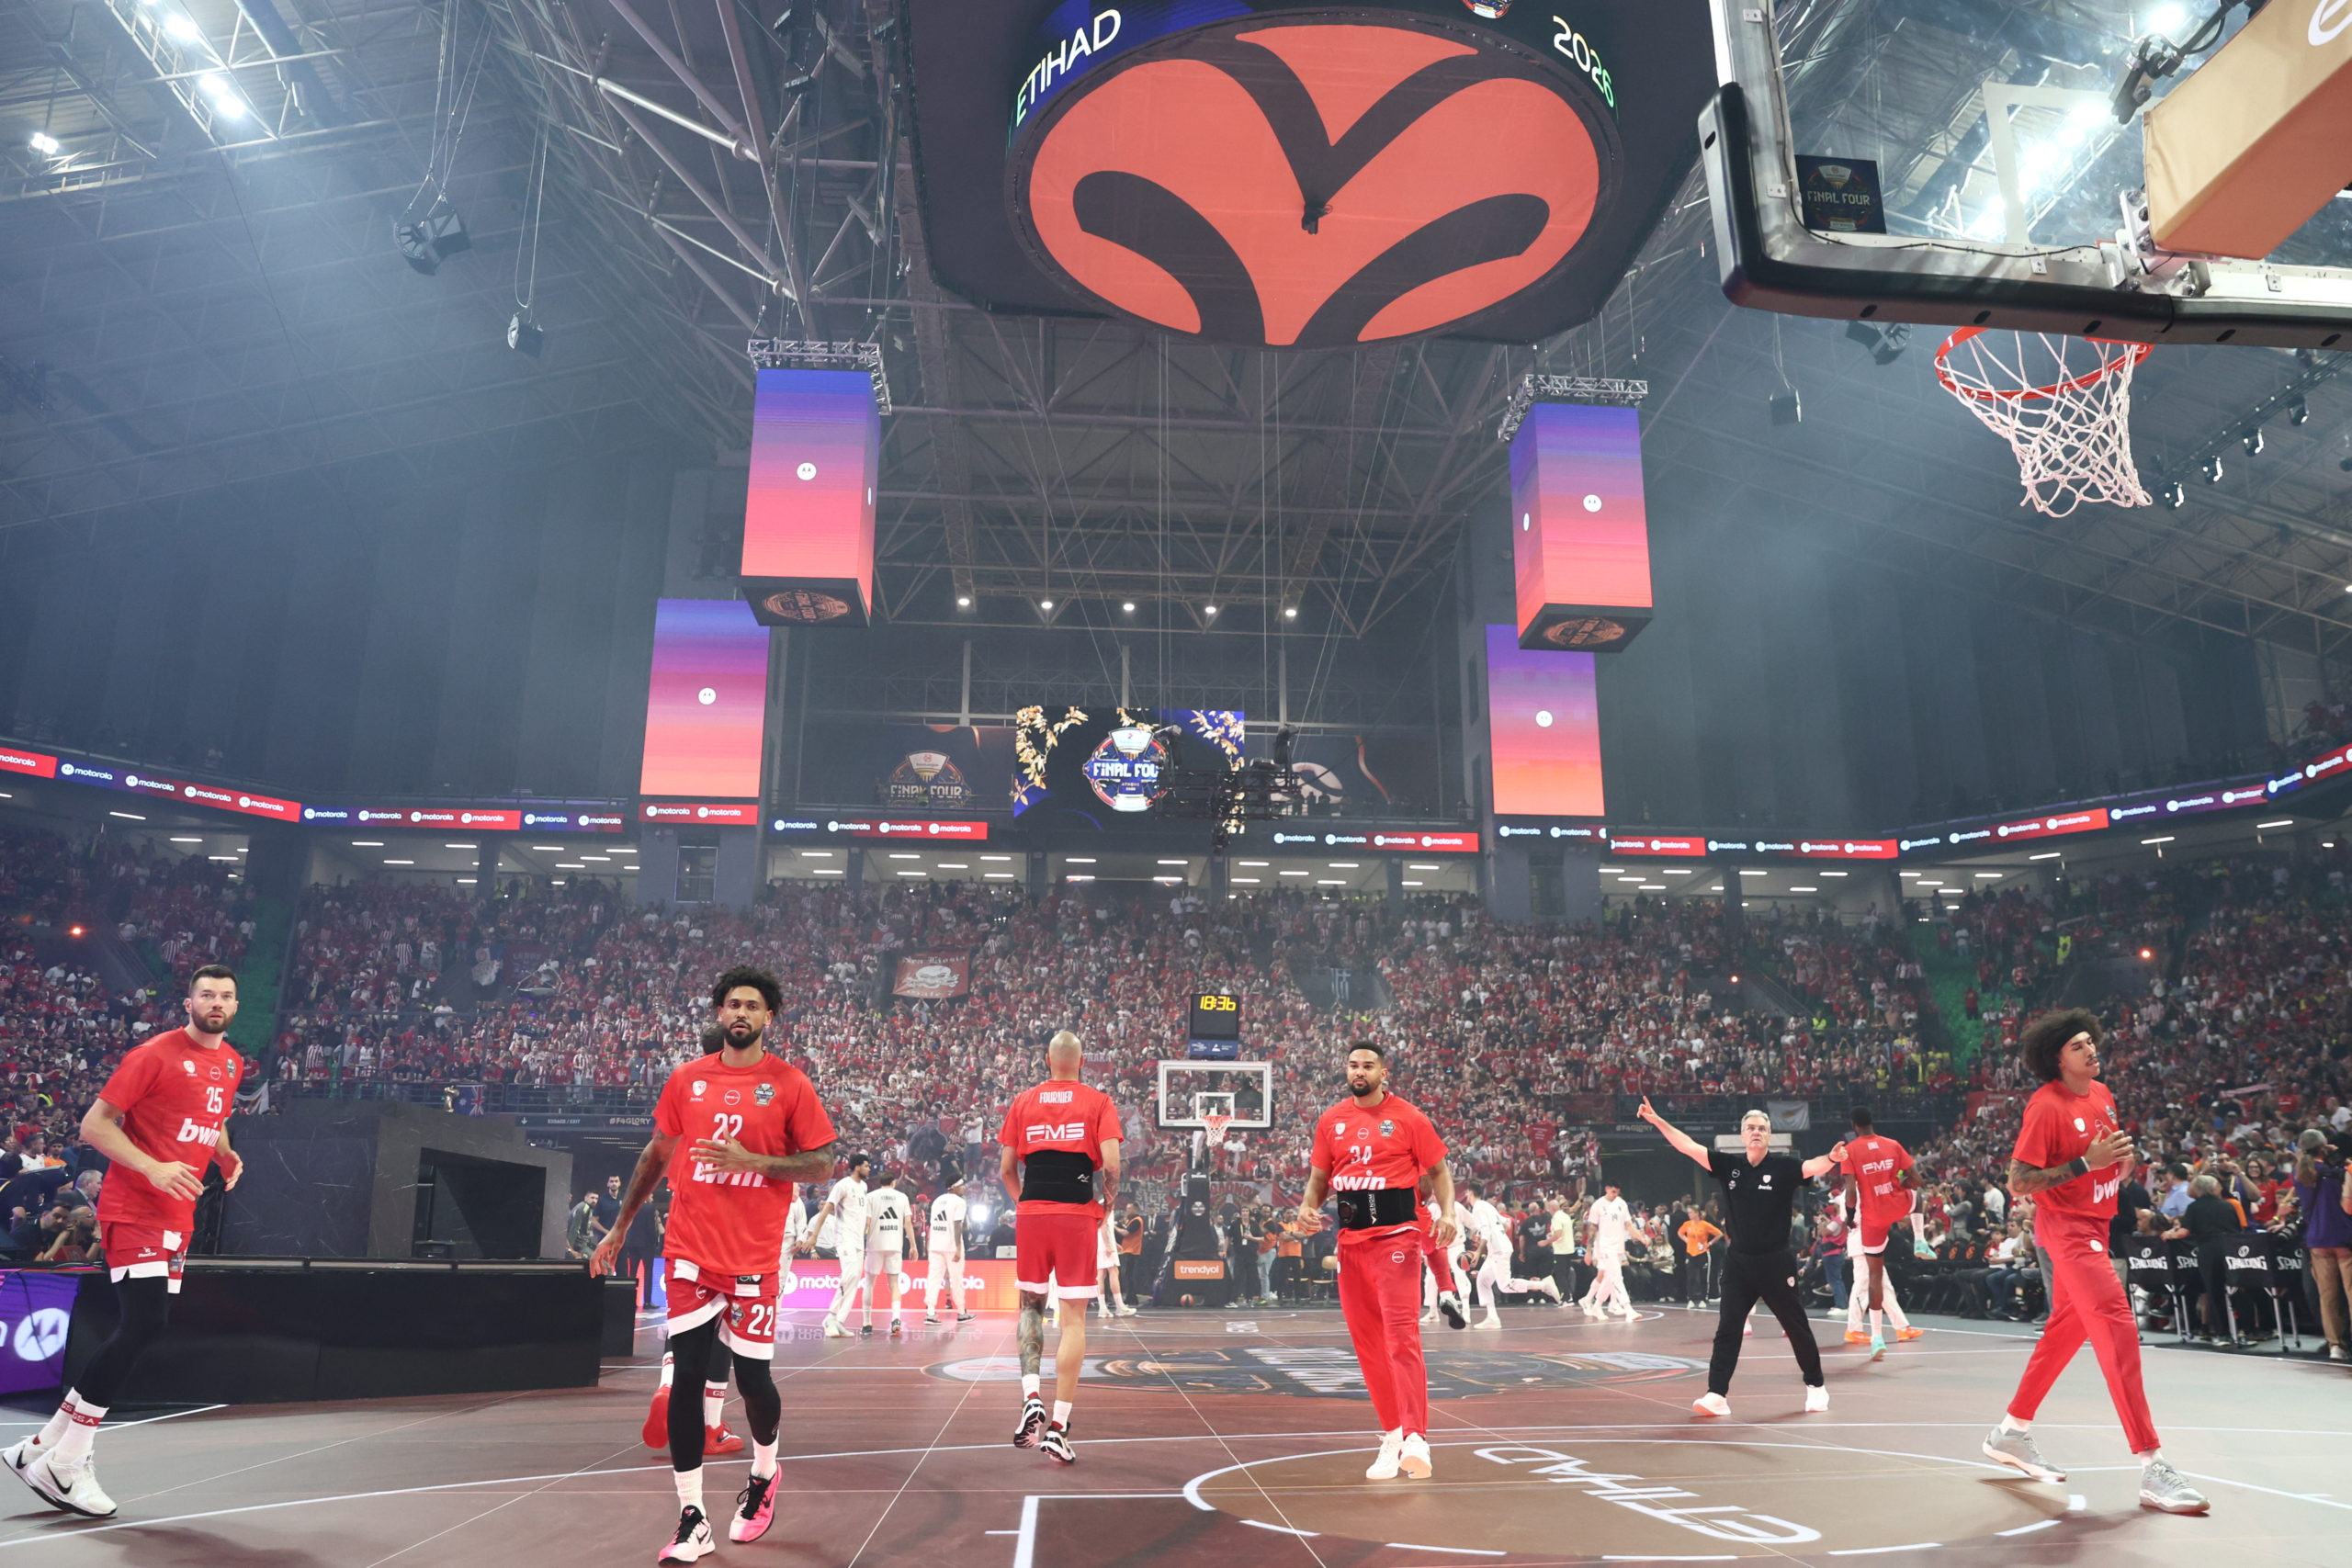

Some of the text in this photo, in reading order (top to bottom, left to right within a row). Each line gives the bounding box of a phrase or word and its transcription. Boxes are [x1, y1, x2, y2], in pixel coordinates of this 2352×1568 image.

[1553, 15, 1614, 107] 2026
[1016, 9, 1122, 127] ETIHAD
[1807, 190, 1871, 206] FINAL FOUR
[74, 766, 113, 781] motorola
[1093, 762, 1159, 778] FINAL FOU
[139, 778, 175, 792] motorola
[197, 789, 232, 802] motorola
[890, 785, 962, 798] FINA FOUR
[251, 799, 285, 812] motorola
[2178, 796, 2213, 809] motorola
[315, 810, 347, 818] motorola
[369, 812, 401, 820] motorola
[658, 807, 690, 816] motorola
[708, 808, 741, 817] motorola
[2122, 805, 2156, 817] motorola
[422, 813, 454, 821] motorola
[472, 814, 504, 822] motorola
[536, 815, 567, 823] motorola
[589, 817, 621, 825] motorola
[2057, 815, 2090, 828] motorola
[786, 820, 817, 829] motorola
[839, 822, 870, 830] motorola
[889, 823, 922, 832] motorola
[940, 825, 971, 833] motorola
[2008, 822, 2041, 835] motorola
[1510, 827, 1541, 835] motorola
[1561, 828, 1591, 837] motorola
[1960, 829, 1990, 840] motorola
[1284, 834, 1316, 842] motorola
[1336, 835, 1366, 843] motorola
[1385, 836, 1415, 844] motorola
[1431, 837, 1463, 845] motorola
[1911, 837, 1939, 847] motorola
[1717, 841, 1747, 850] motorola
[1765, 842, 1793, 851] motorola
[1854, 843, 1883, 852] motorola
[1200, 995, 1237, 1011] 18:36
[206, 1087, 224, 1114] 25
[1039, 1090, 1073, 1104] FOURNIER
[609, 1117, 651, 1126] #F4GLORY
[712, 1112, 743, 1145] 22
[1025, 1122, 1085, 1142] FMS
[1350, 1145, 1373, 1165] 34
[1861, 1158, 1894, 1175] FMS
[1180, 1265, 1220, 1275] trendyol
[747, 1303, 775, 1337] 22
